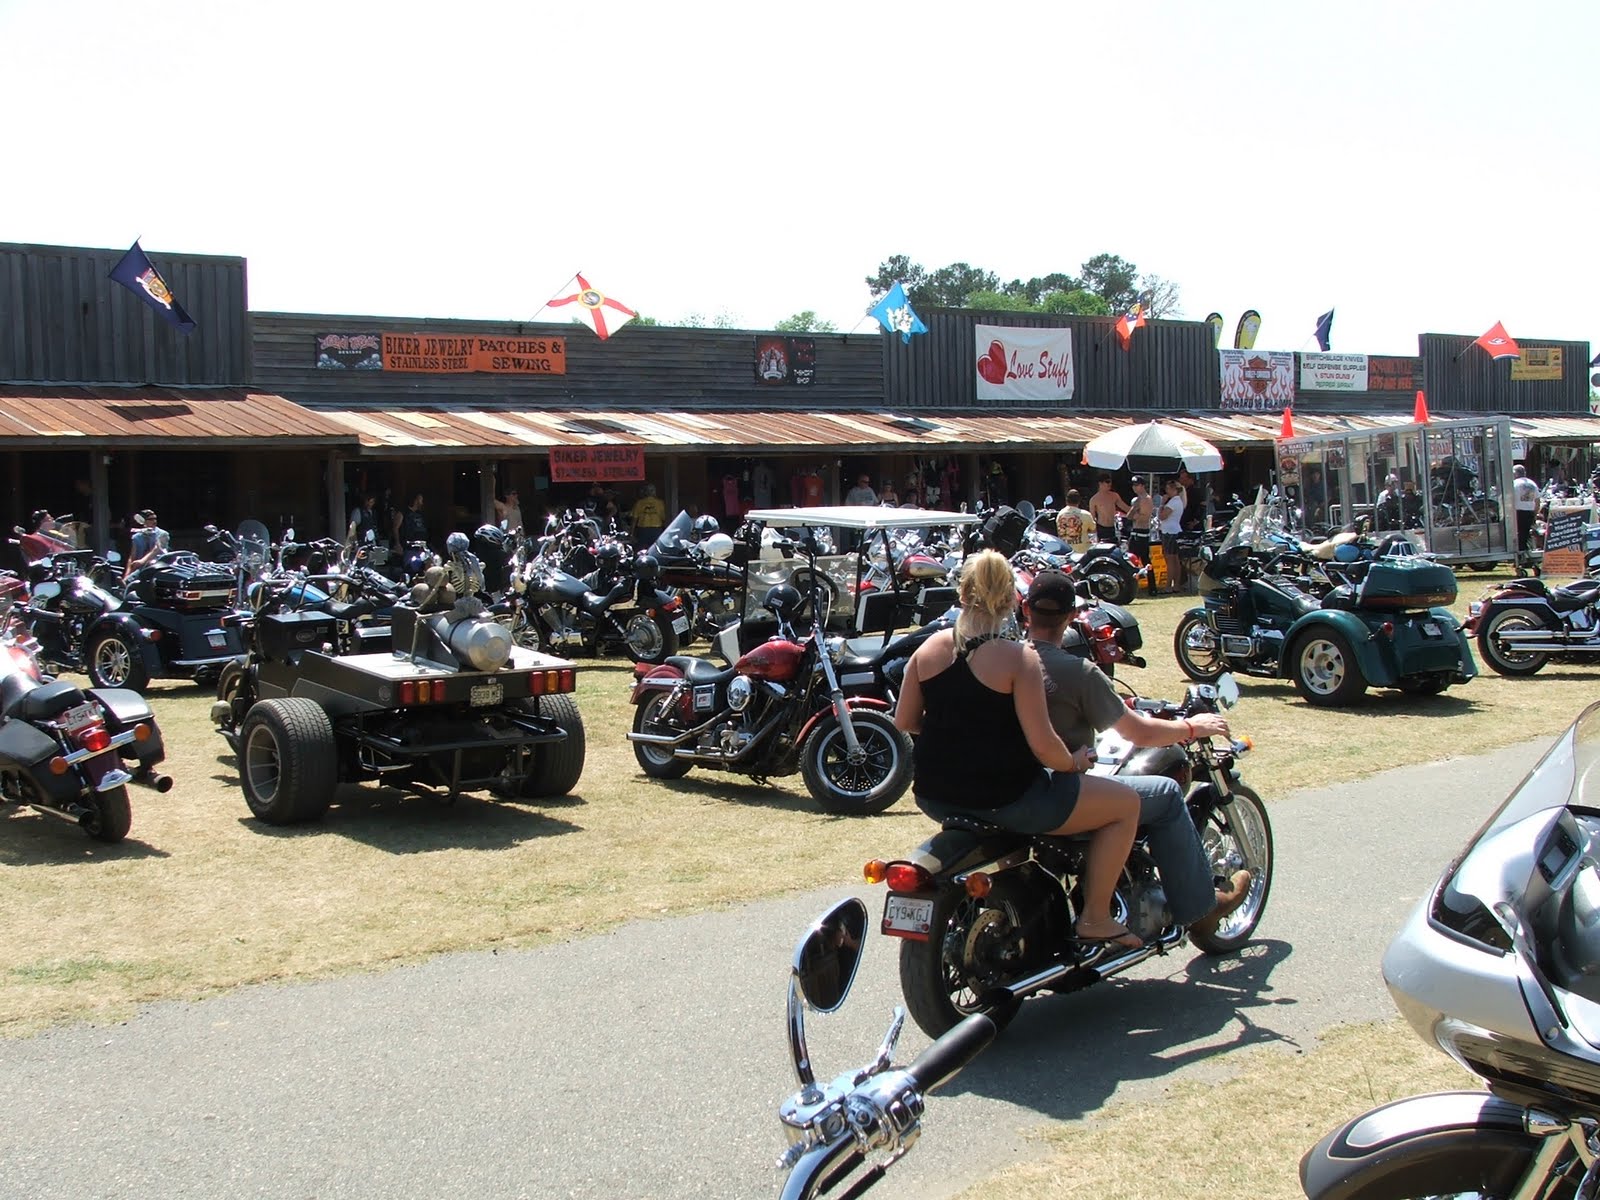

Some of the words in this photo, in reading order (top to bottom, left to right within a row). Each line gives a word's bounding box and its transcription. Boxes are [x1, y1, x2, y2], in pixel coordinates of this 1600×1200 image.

[386, 336, 420, 355] BIKER
[424, 338, 474, 356] JEWELRY
[478, 338, 546, 354] PATCHES
[551, 341, 562, 354] &
[390, 356, 440, 370] STAINLESS
[442, 357, 468, 370] STEEL
[492, 357, 551, 371] SEWING
[1006, 350, 1034, 379] Love
[1038, 350, 1069, 388] Stuff
[554, 450, 587, 463] BIKER
[591, 448, 638, 462] JEWELRY
[556, 467, 596, 478] STAINLESS
[1555, 522, 1577, 531] Harley
